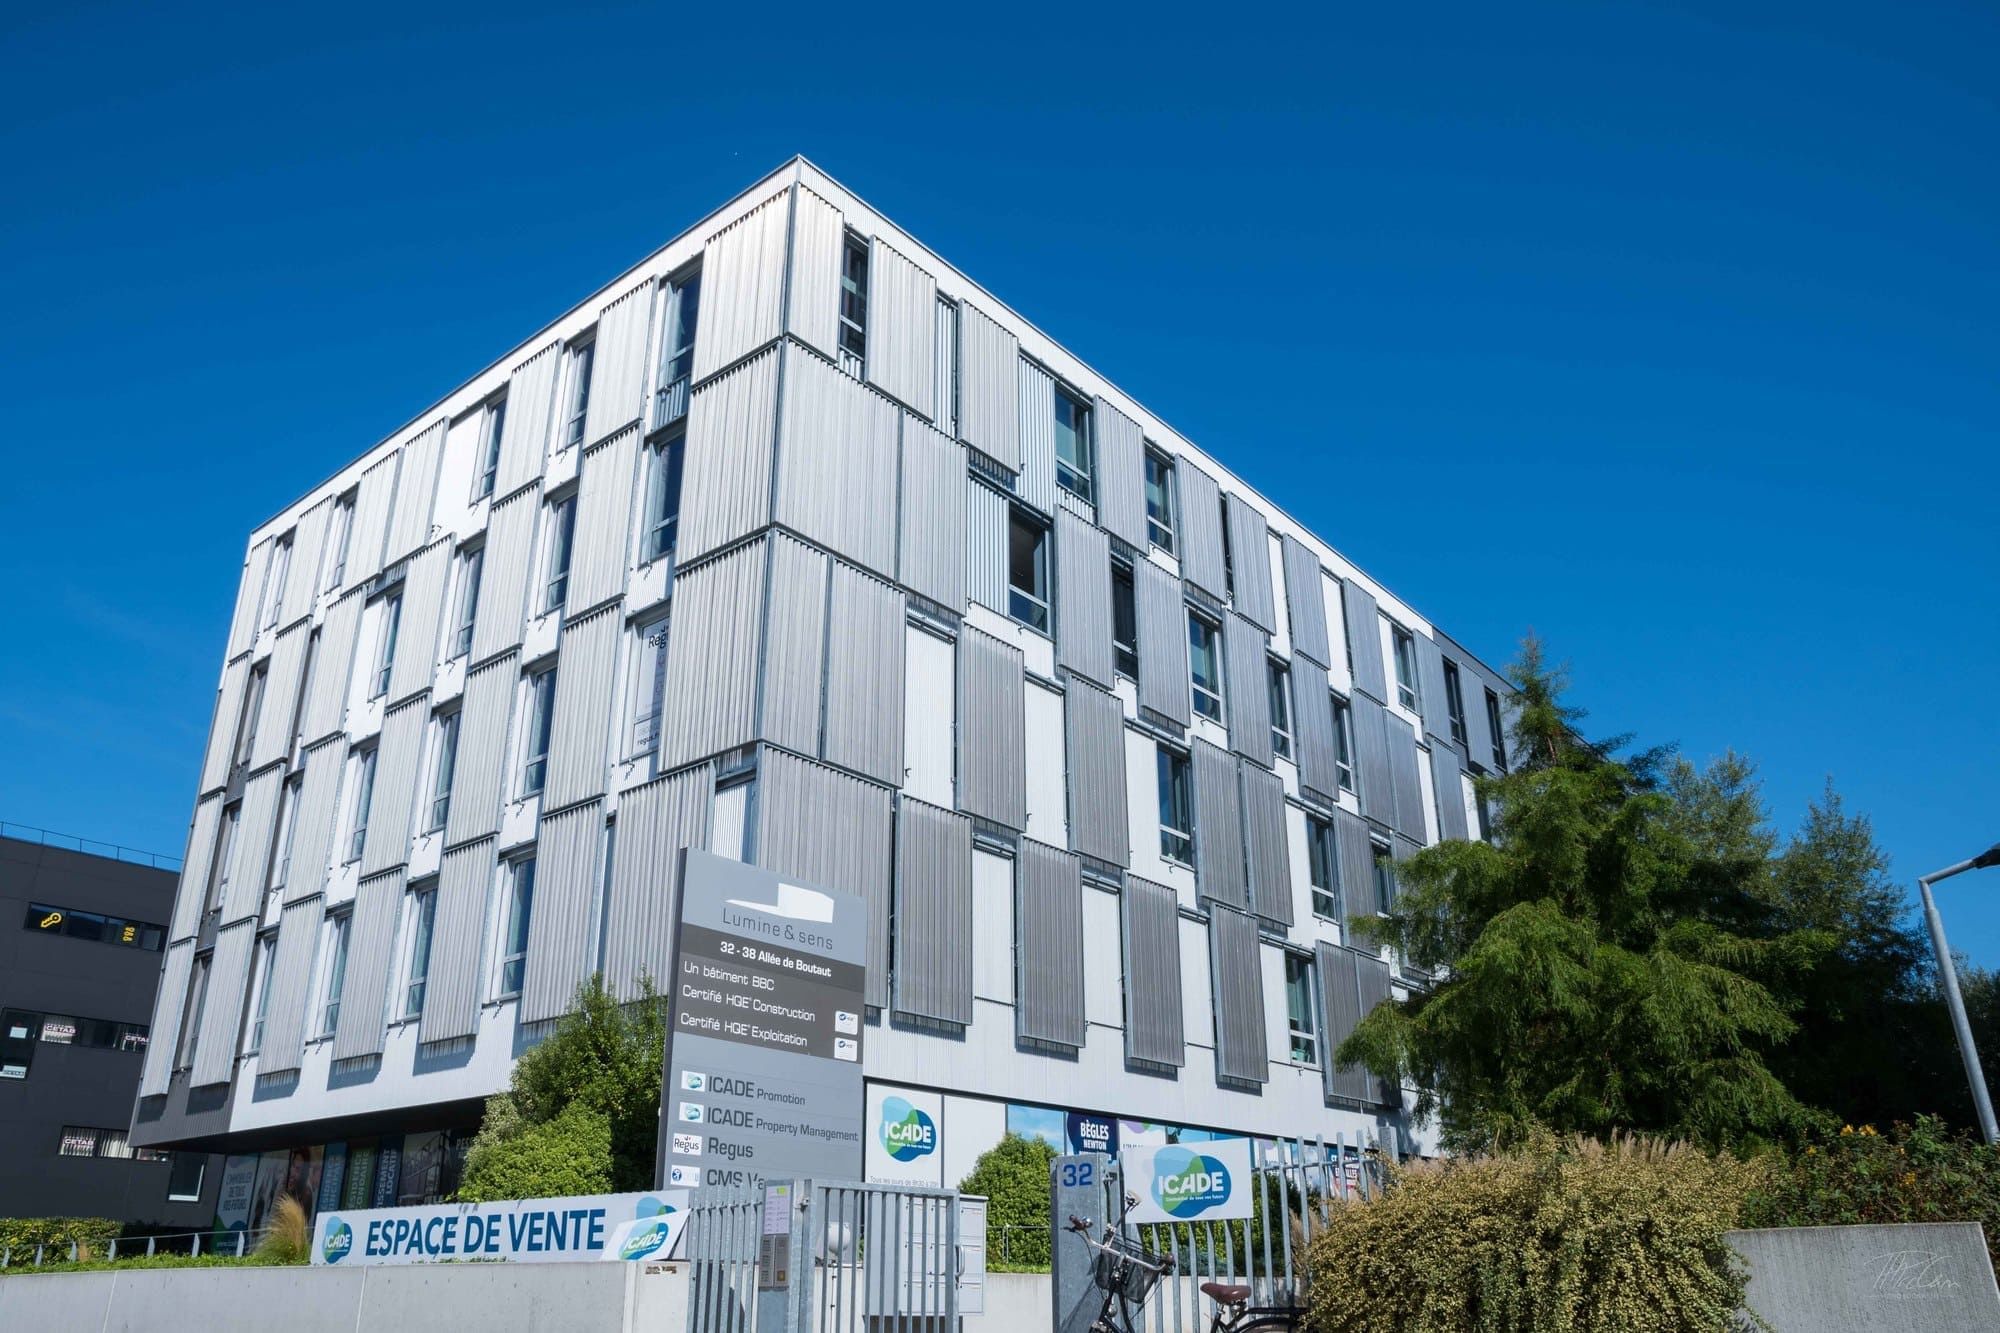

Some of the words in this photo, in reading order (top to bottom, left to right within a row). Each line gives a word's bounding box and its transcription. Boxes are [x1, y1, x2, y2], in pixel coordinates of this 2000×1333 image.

[722, 907, 780, 937] Lumine
[784, 924, 795, 940] &
[798, 930, 833, 950] sens
[720, 941, 735, 955] 32
[742, 946, 756, 960] 38
[758, 950, 781, 967] Allée
[783, 956, 794, 969] de
[796, 960, 832, 977] Boutaut
[684, 961, 699, 975] Un
[703, 964, 749, 985] bâtiment
[752, 975, 775, 991] BBC
[682, 984, 722, 1003] Certifié
[753, 999, 816, 1022] Construction
[680, 1012, 721, 1031] Certifié
[751, 1025, 808, 1047] Exploitation
[708, 1075, 755, 1099] ICADE
[757, 1088, 806, 1106] Promotion
[706, 1106, 754, 1128] ICADE
[756, 1118, 798, 1137] Property
[800, 1124, 859, 1142] Management
[884, 1121, 932, 1143] ICADE
[1080, 1119, 1109, 1140] BÈGLES
[674, 1138, 700, 1153] Regus
[708, 1137, 754, 1160] Regus
[1083, 1139, 1107, 1150] NEWTON
[706, 1168, 743, 1188] CMS
[1063, 1162, 1093, 1187] 32
[1158, 1171, 1224, 1195] ICADE
[324, 1234, 351, 1249] ICADE
[365, 1217, 459, 1256] ESPACE
[463, 1214, 501, 1253] DE
[508, 1208, 606, 1252] VENTE
[624, 1231, 665, 1250] ICADE
